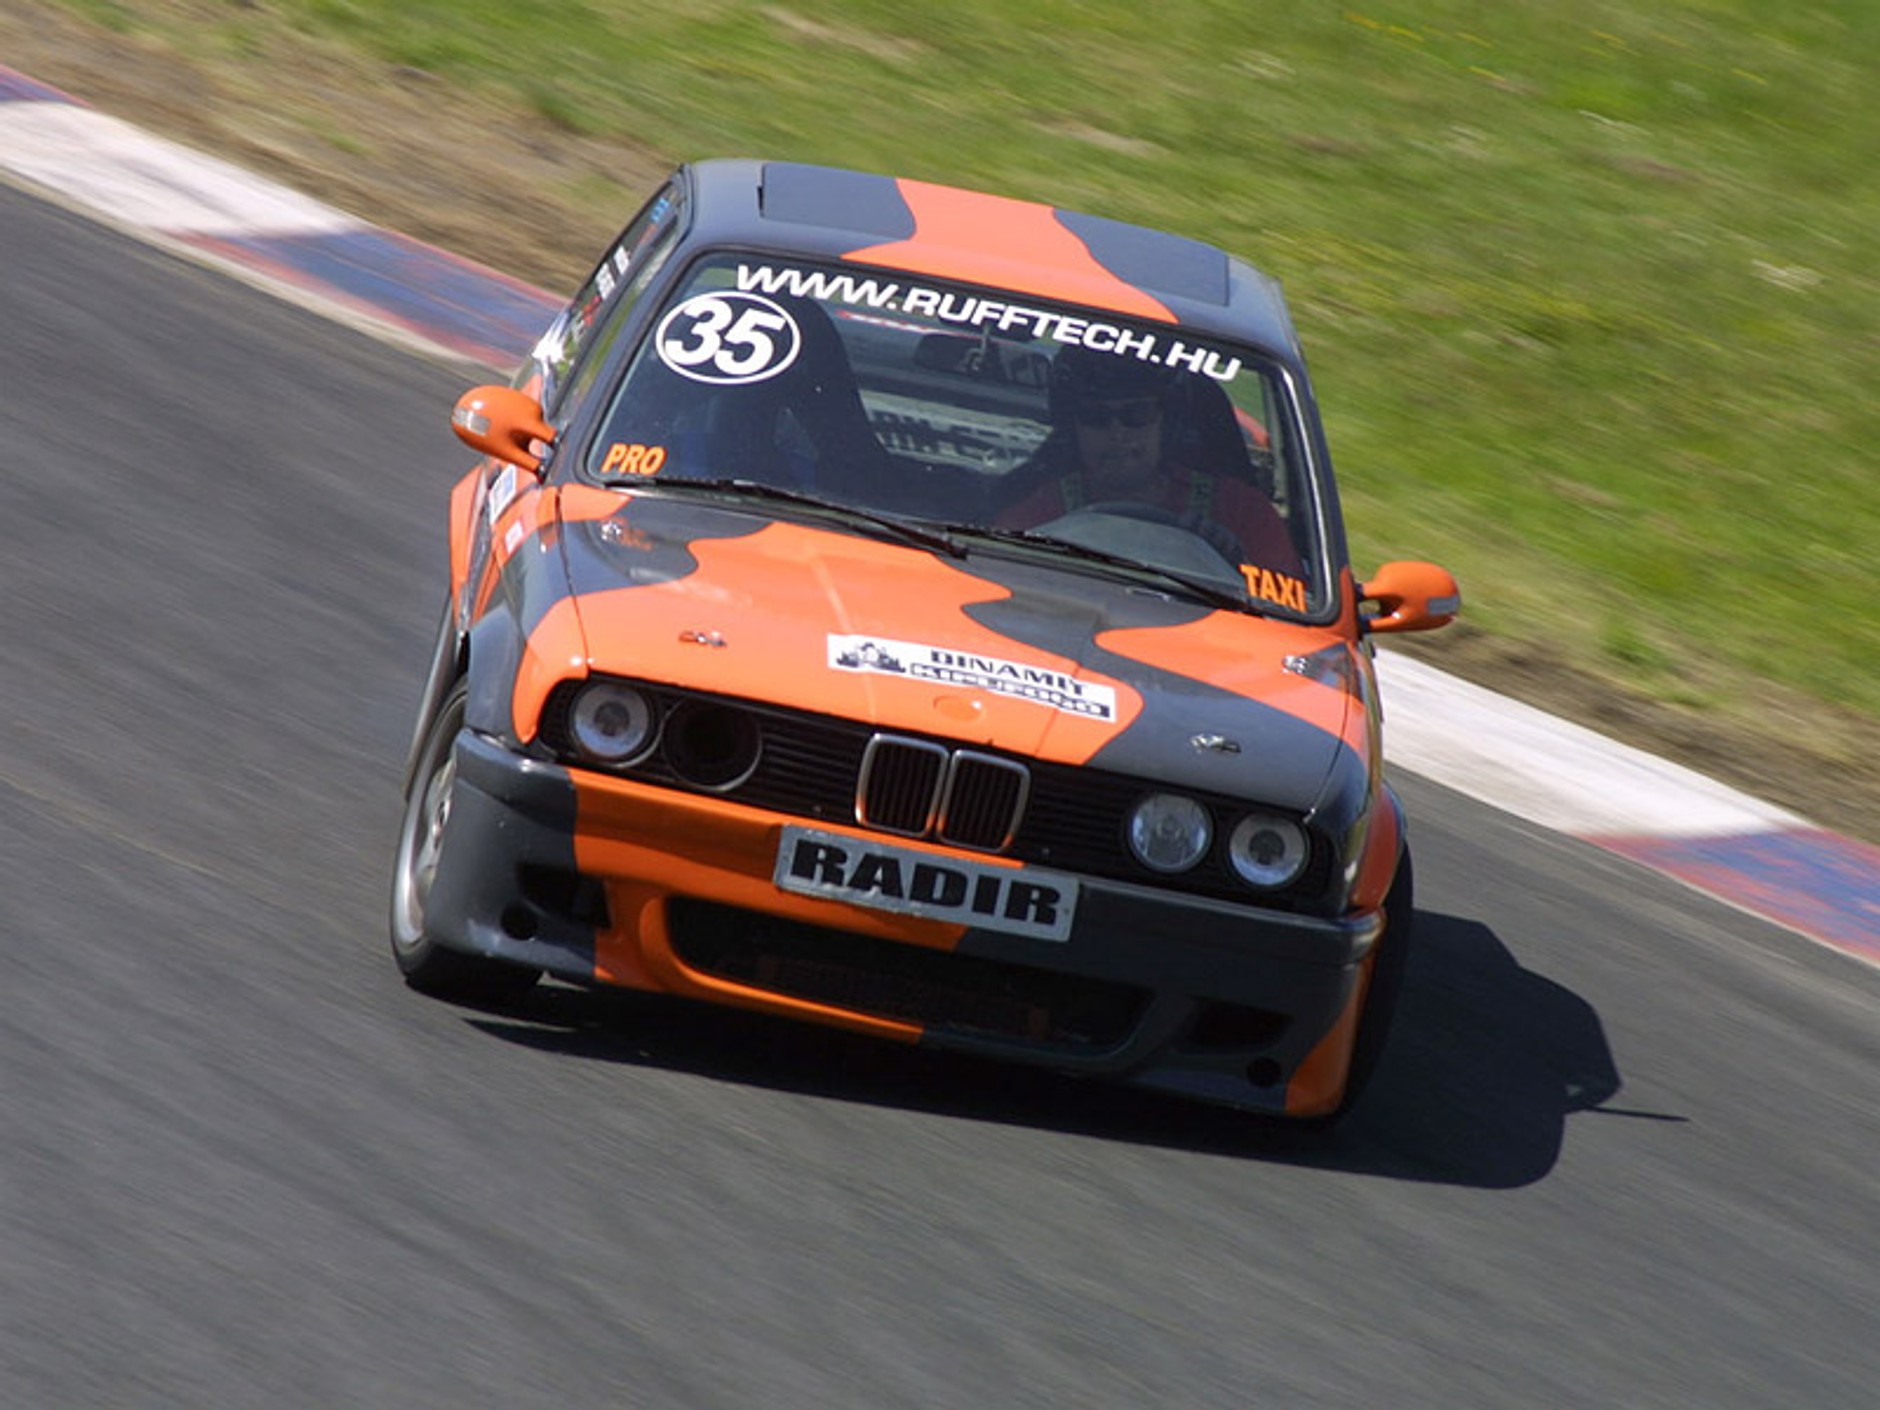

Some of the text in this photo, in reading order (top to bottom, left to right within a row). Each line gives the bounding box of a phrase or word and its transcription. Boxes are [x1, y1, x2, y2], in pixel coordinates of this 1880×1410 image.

[664, 298, 787, 375] 35
[737, 264, 1242, 383] WWW.RUFFTECH.HU
[600, 443, 667, 476] PRO
[1238, 563, 1307, 614] TAXI
[790, 838, 1062, 926] RADIR
